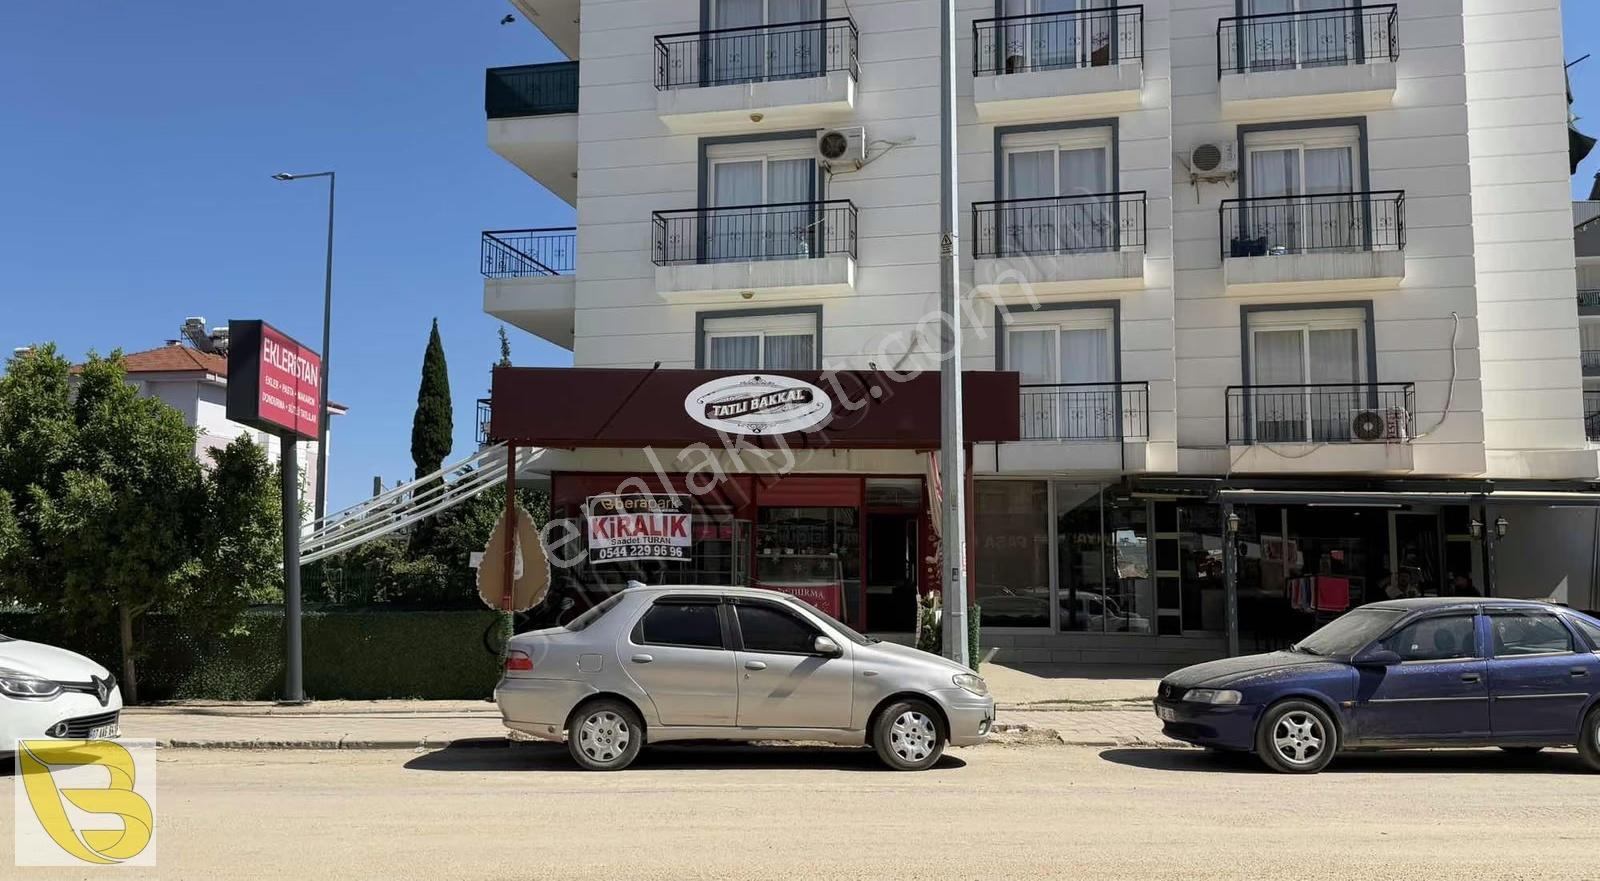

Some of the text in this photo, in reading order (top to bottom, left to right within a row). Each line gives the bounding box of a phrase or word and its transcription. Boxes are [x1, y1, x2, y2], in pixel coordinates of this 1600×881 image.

[712, 389, 806, 417] TATLI BAKKAL
[610, 536, 671, 546] Saadet TURAN
[599, 545, 683, 559] 0544 229 96 96
